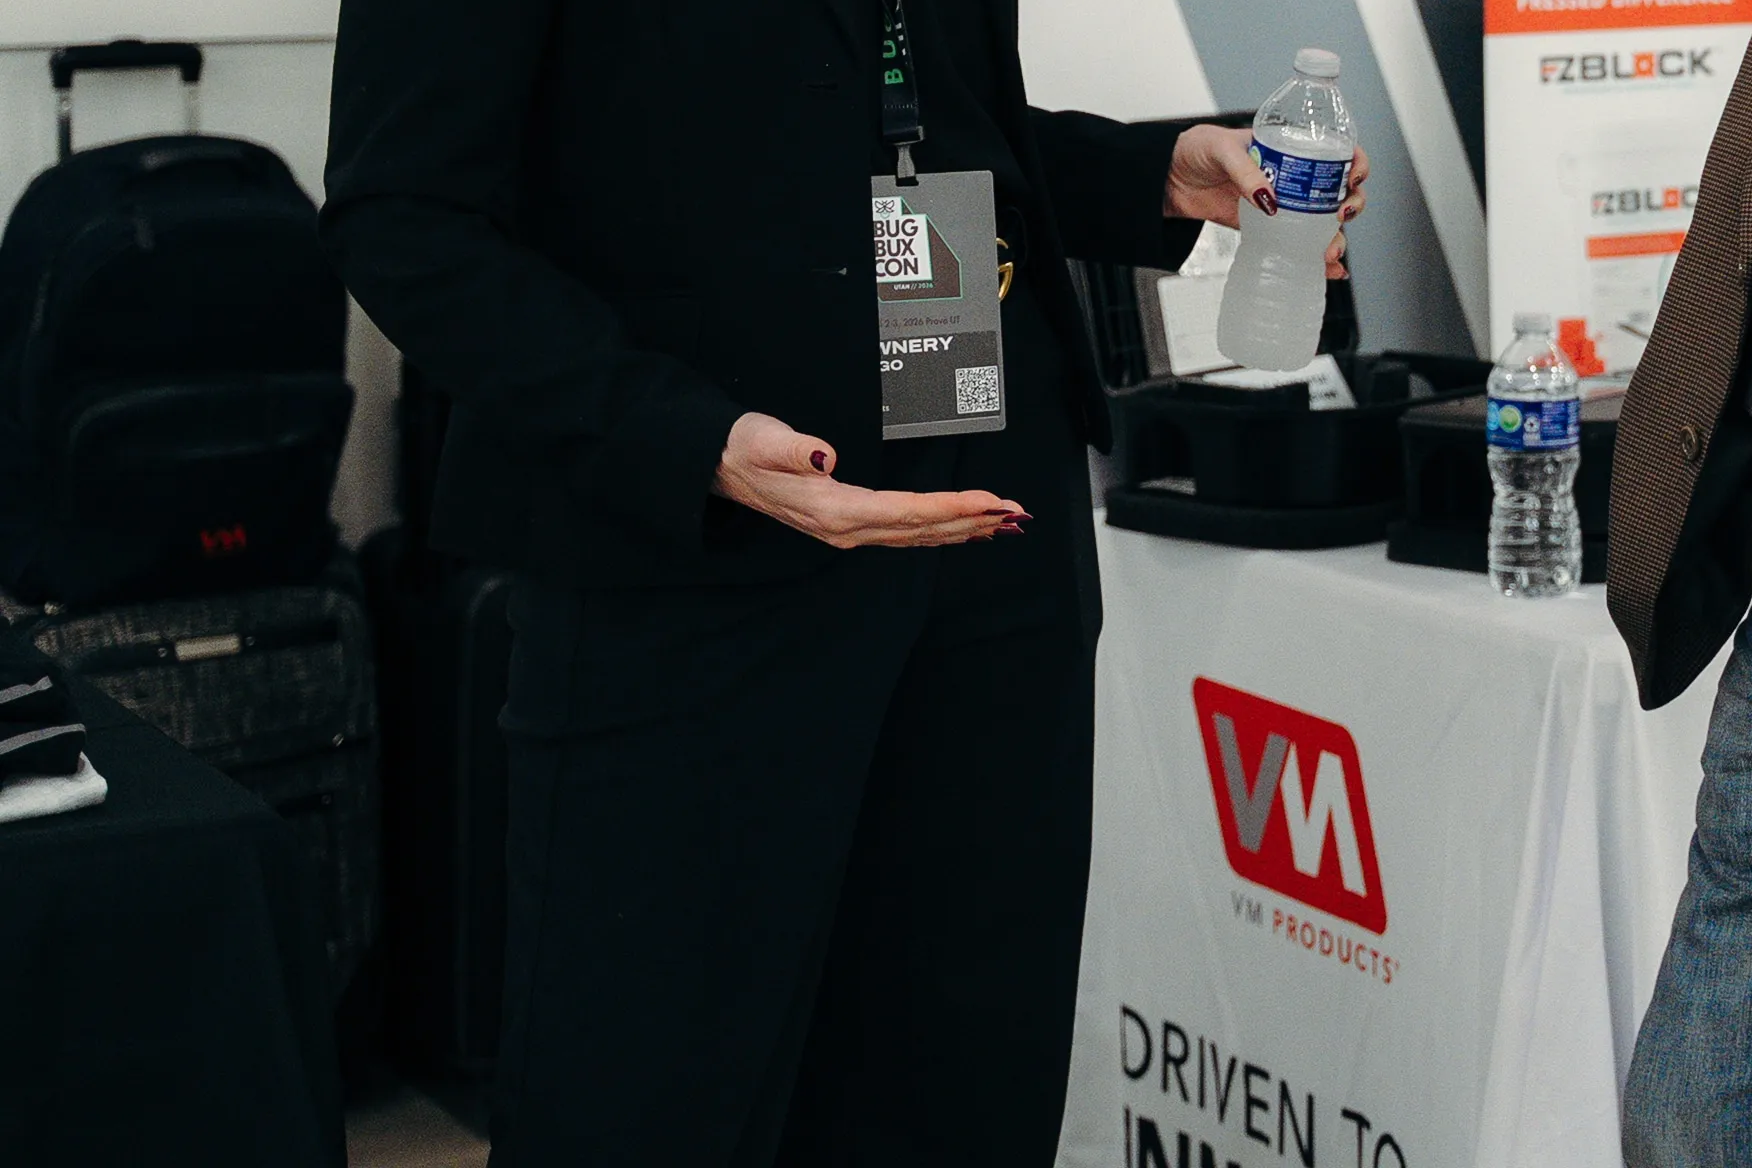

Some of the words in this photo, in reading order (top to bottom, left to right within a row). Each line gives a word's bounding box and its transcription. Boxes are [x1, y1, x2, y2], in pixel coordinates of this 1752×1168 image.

[874, 218, 919, 238] BUG
[875, 238, 916, 257] BUX
[876, 257, 919, 278] CON
[1231, 891, 1264, 927] VM
[1271, 908, 1395, 985] PRODUCTS
[1121, 1003, 1316, 1168] DRIVEN
